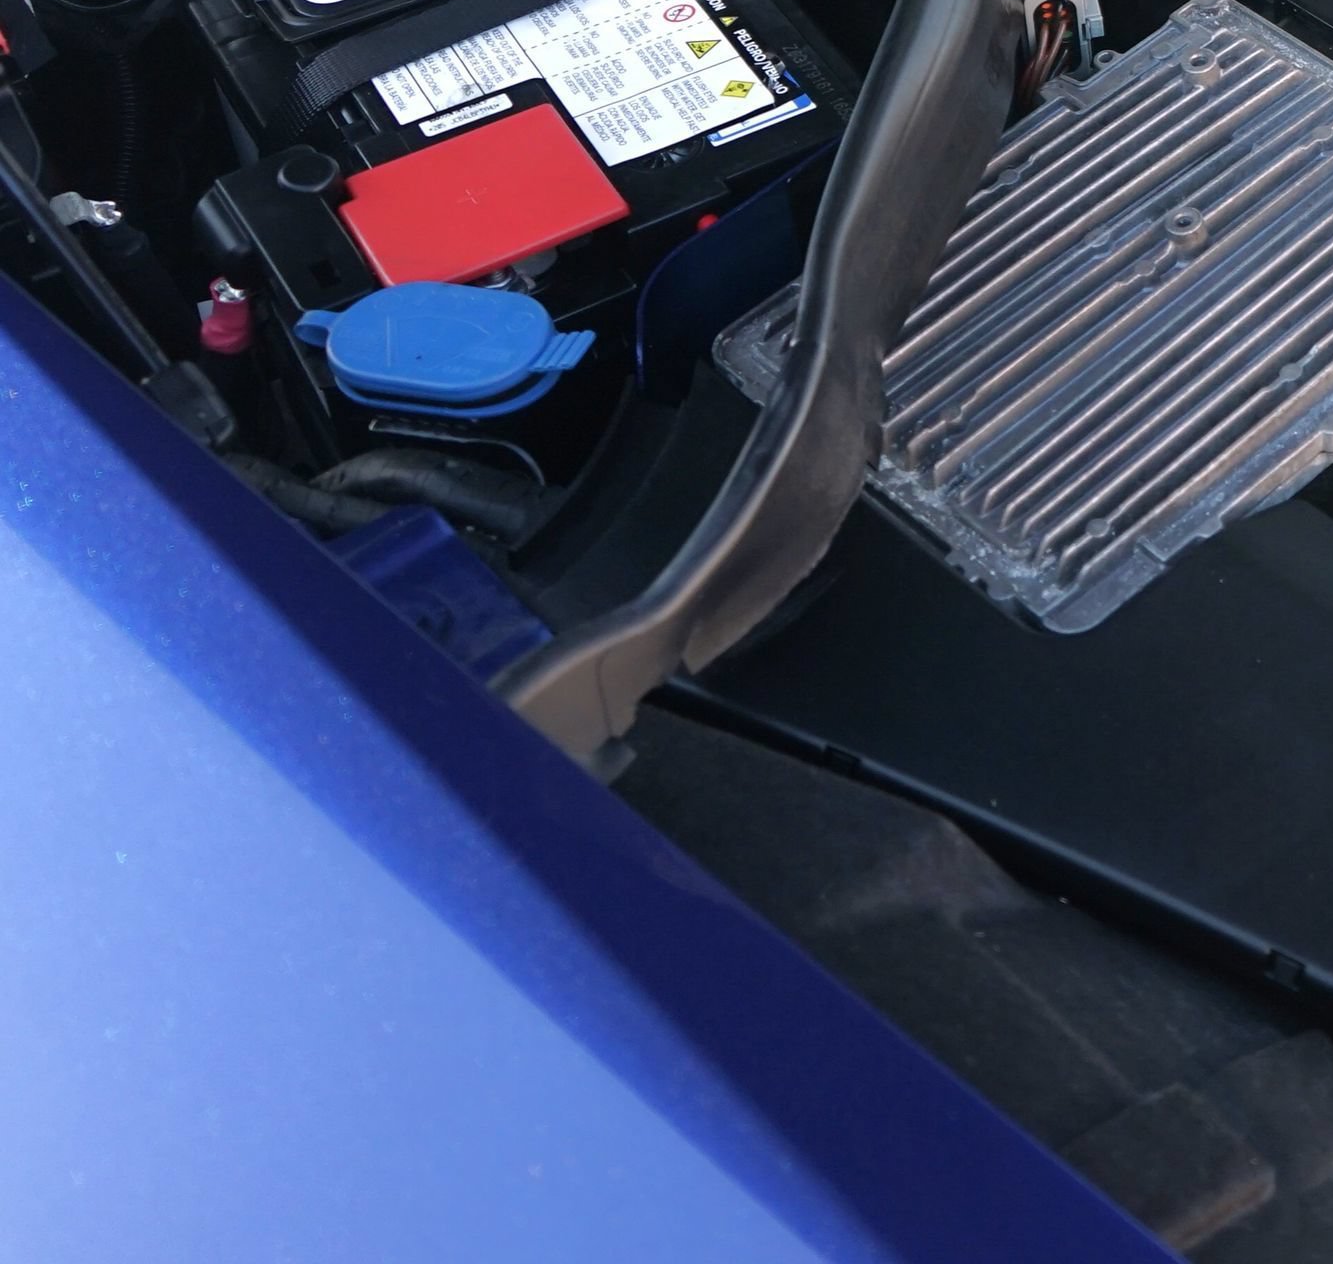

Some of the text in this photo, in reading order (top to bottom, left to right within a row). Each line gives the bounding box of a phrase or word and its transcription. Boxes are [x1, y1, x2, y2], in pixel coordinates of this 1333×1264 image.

[670, 83, 686, 96] WITH
[690, 75, 717, 103] FLUSH EYES
[660, 87, 682, 108] MEDICAL
[675, 107, 692, 120] HELP
